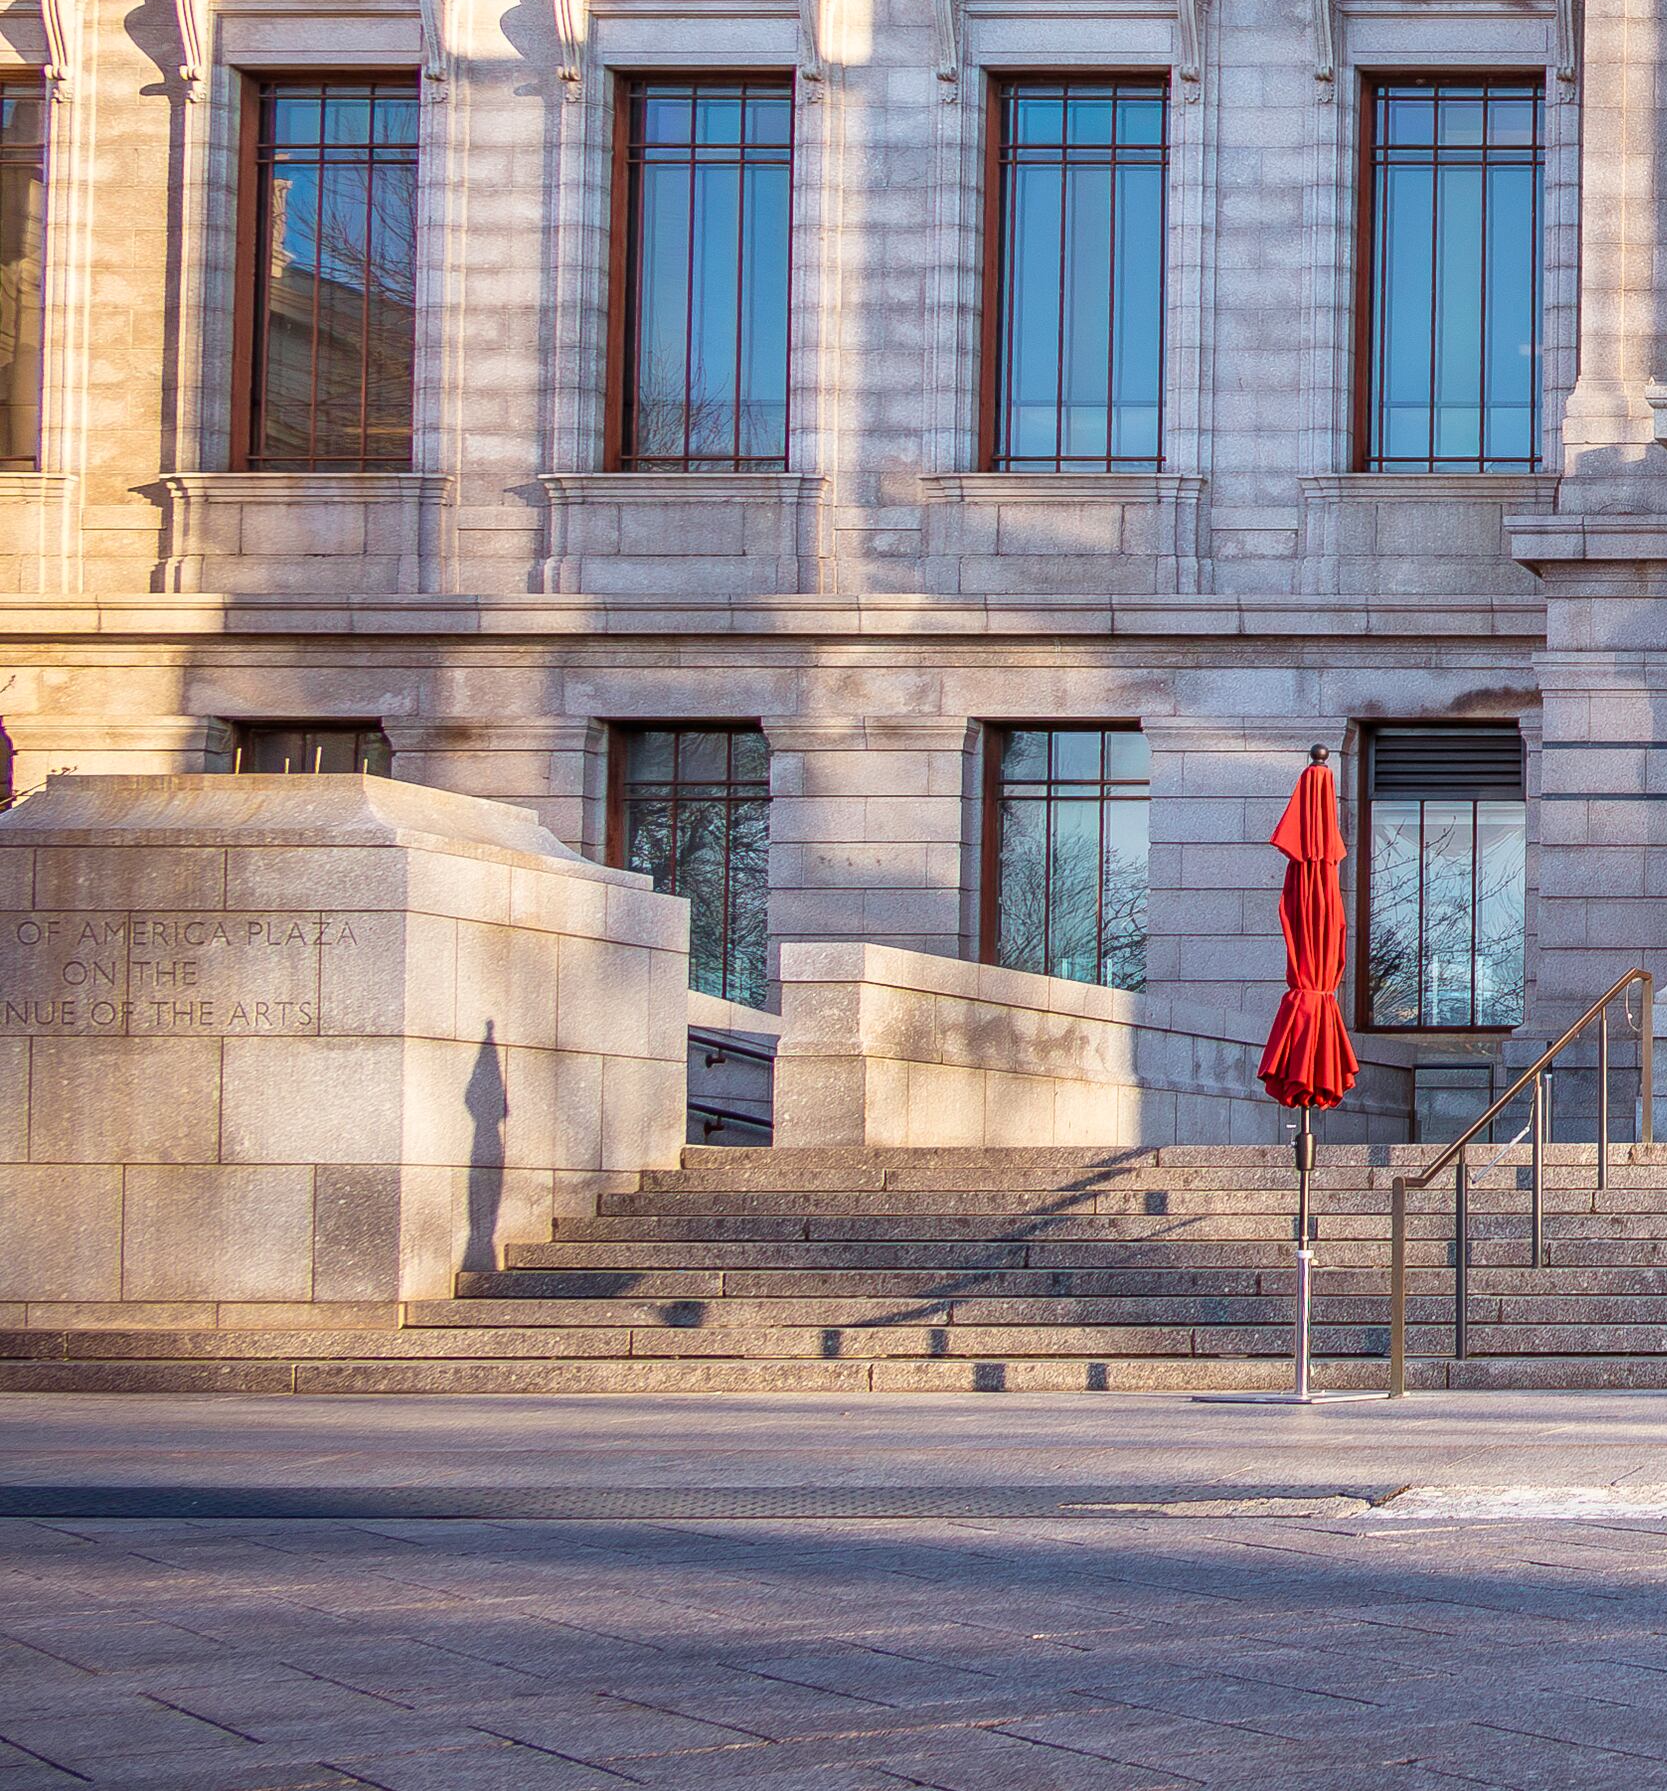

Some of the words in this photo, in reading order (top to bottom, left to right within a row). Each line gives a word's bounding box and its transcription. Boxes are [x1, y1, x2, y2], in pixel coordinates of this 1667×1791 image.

[16, 920, 60, 946] OF
[76, 920, 232, 946] AMERICA
[246, 920, 358, 947] PLAZA
[62, 960, 116, 986] ON
[131, 960, 198, 987] THE
[91, 1000, 135, 1026] OF
[150, 1000, 214, 1026] THE
[227, 1000, 313, 1026] ARTS
